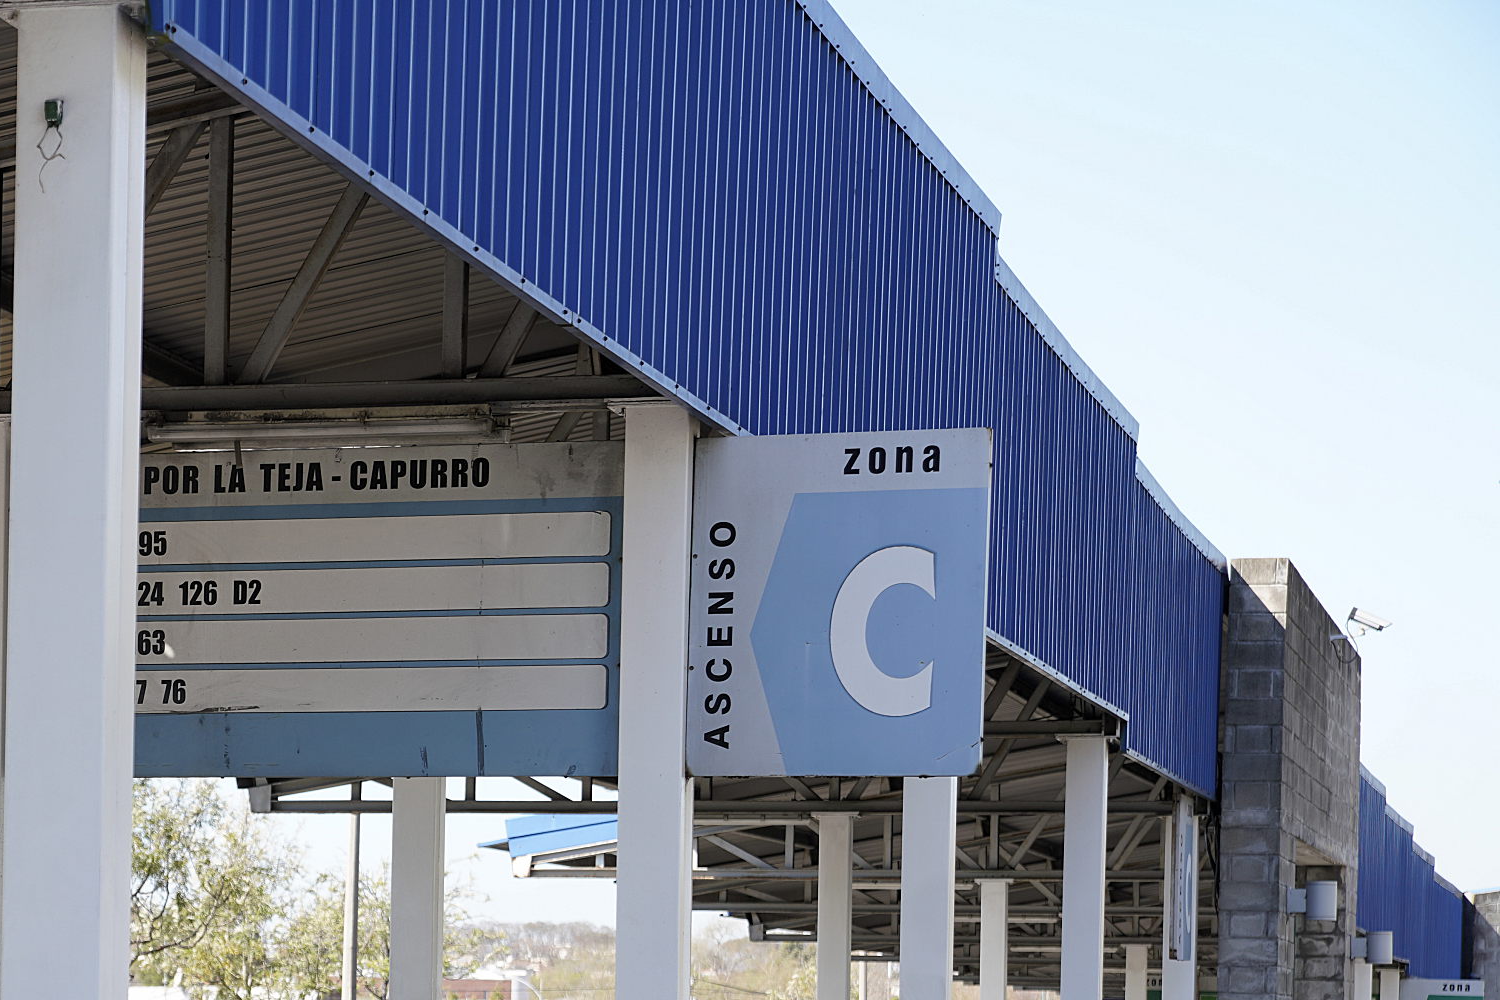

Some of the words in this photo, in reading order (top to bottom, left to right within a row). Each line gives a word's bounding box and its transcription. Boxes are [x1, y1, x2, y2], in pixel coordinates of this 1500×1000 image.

[844, 444, 941, 475] zona
[144, 465, 199, 495] POR
[214, 464, 246, 494] LA
[260, 462, 324, 493] TEJA
[350, 457, 490, 491] CAPURRO
[138, 531, 167, 556] 95
[138, 581, 164, 607] 24
[178, 580, 218, 606] 126
[233, 579, 262, 605] D2
[137, 629, 166, 655] 63
[704, 521, 737, 750] ASCENSO
[830, 545, 936, 717] C
[161, 679, 187, 704] 76
[1442, 983, 1471, 992] zona
